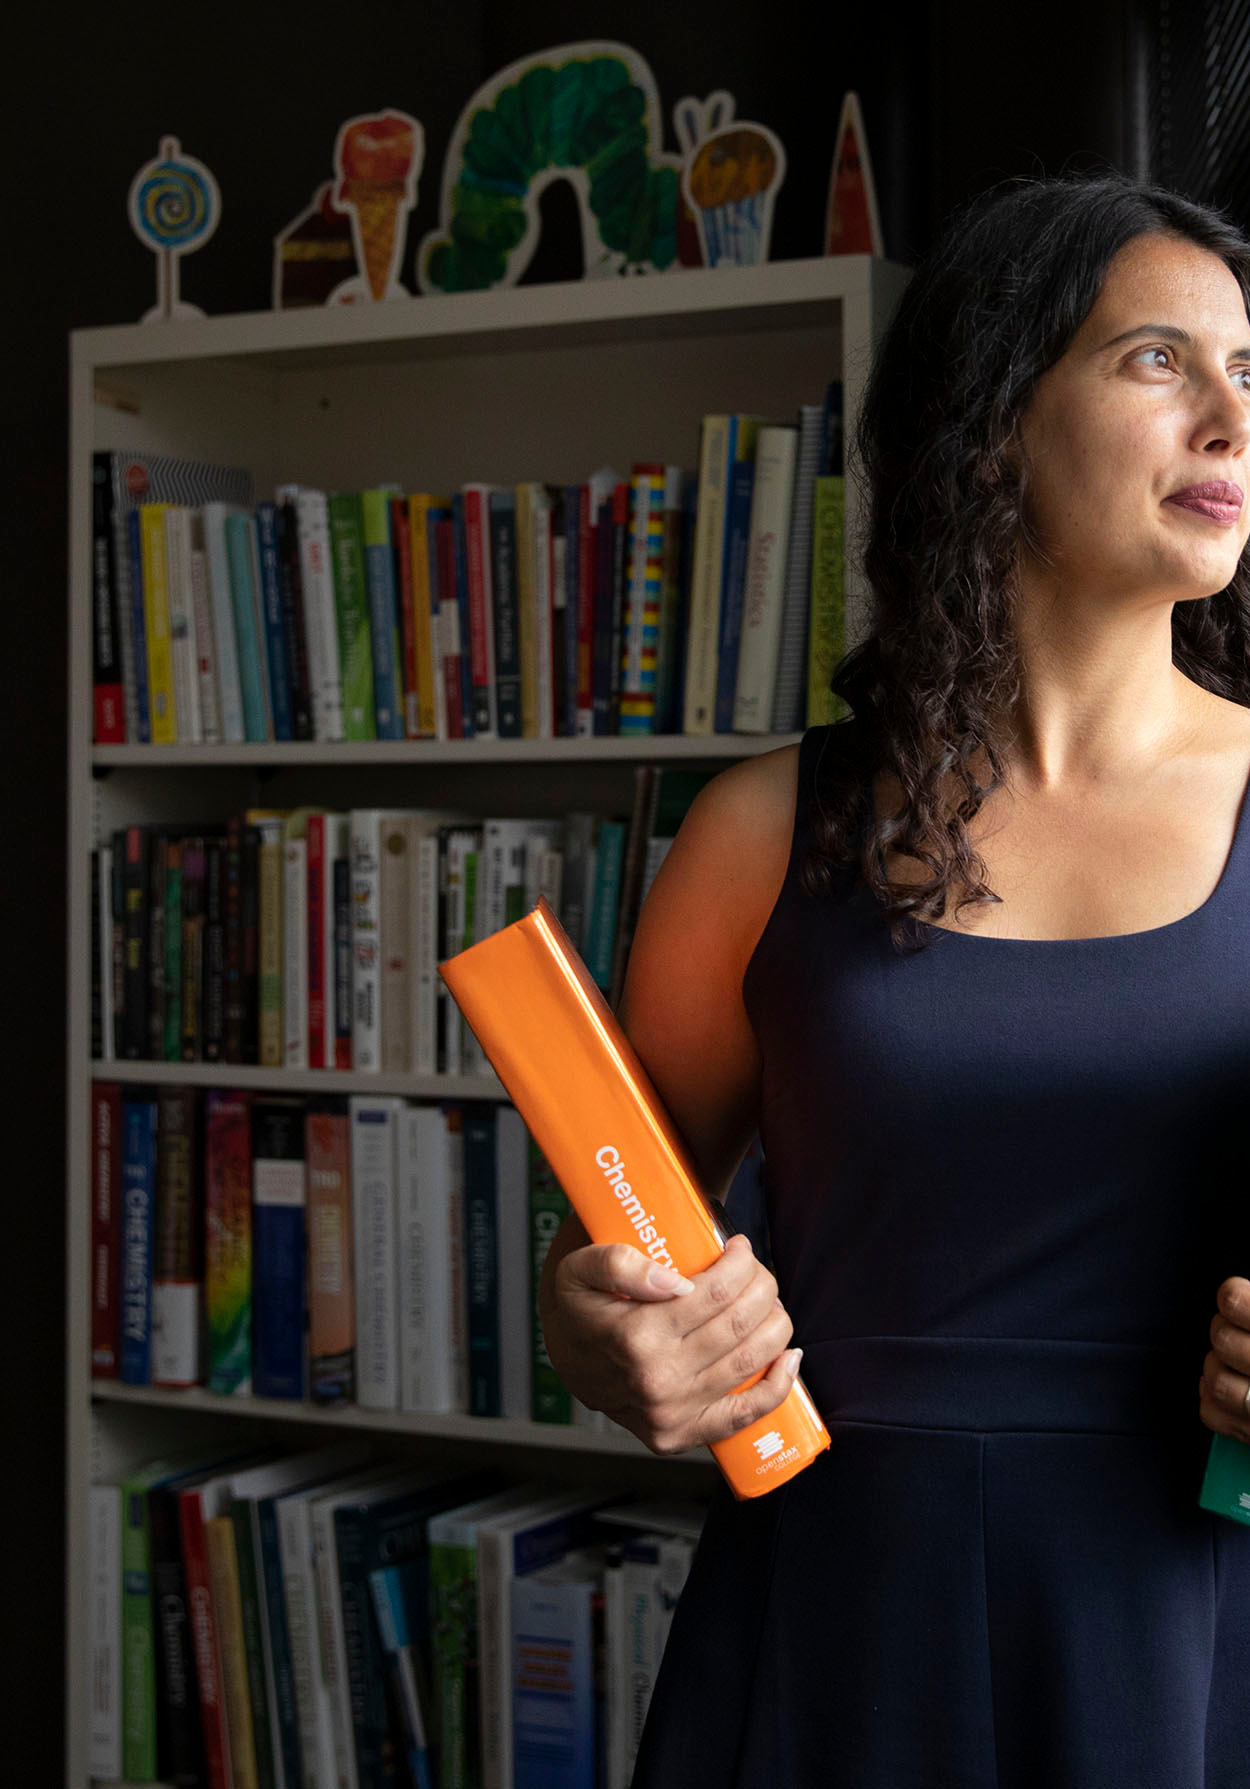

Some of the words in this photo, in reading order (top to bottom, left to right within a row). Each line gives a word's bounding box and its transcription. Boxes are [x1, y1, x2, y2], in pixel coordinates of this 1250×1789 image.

[125, 1188, 149, 1342] CHEMISTRY
[755, 1446, 799, 1475] openstax
[161, 1594, 187, 1708] Chemistry
